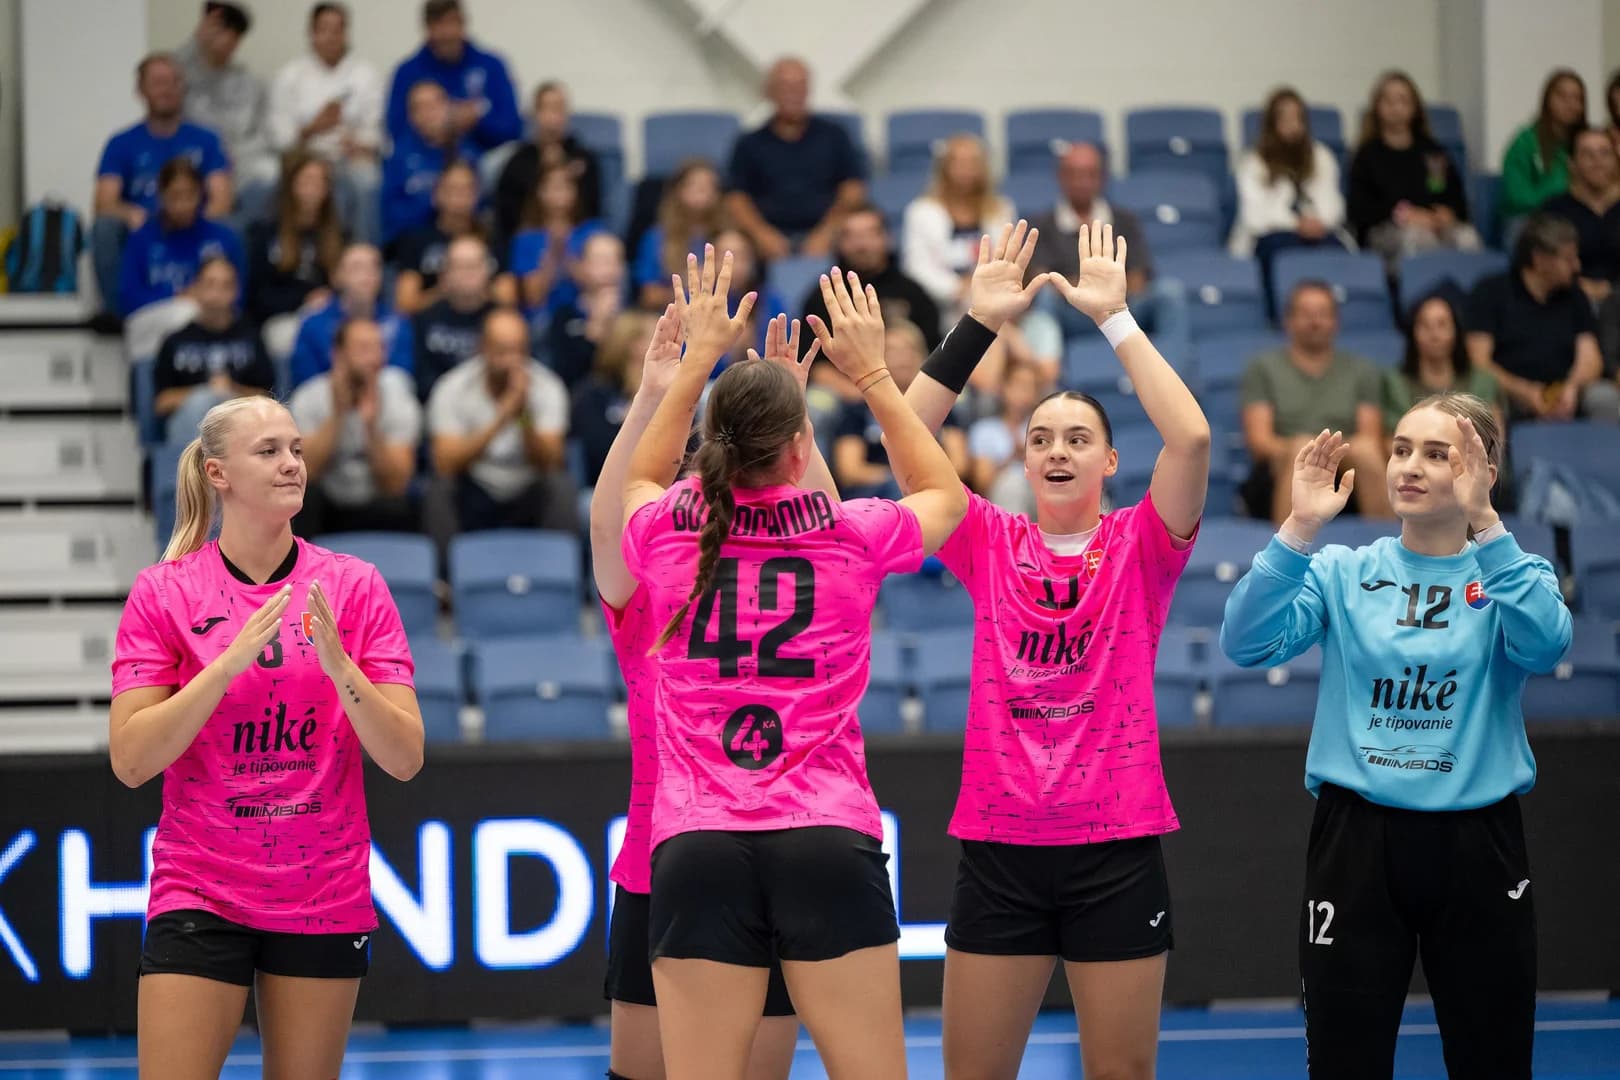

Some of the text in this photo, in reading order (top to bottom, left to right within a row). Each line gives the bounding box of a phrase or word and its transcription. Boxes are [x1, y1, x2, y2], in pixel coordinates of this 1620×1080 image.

[687, 556, 815, 678] 42
[1396, 583, 1452, 629] 12
[1015, 619, 1094, 664] niké
[1034, 700, 1096, 720] MBDS
[1370, 663, 1458, 712] niké
[232, 702, 318, 754] niké
[730, 713, 770, 762] 4
[762, 719, 777, 729] KA
[1367, 713, 1453, 732] je tipovanie
[233, 759, 317, 776] je tipovanie
[1393, 759, 1453, 773] MBDS
[262, 801, 323, 818] MBDS
[1308, 900, 1336, 945] 12
